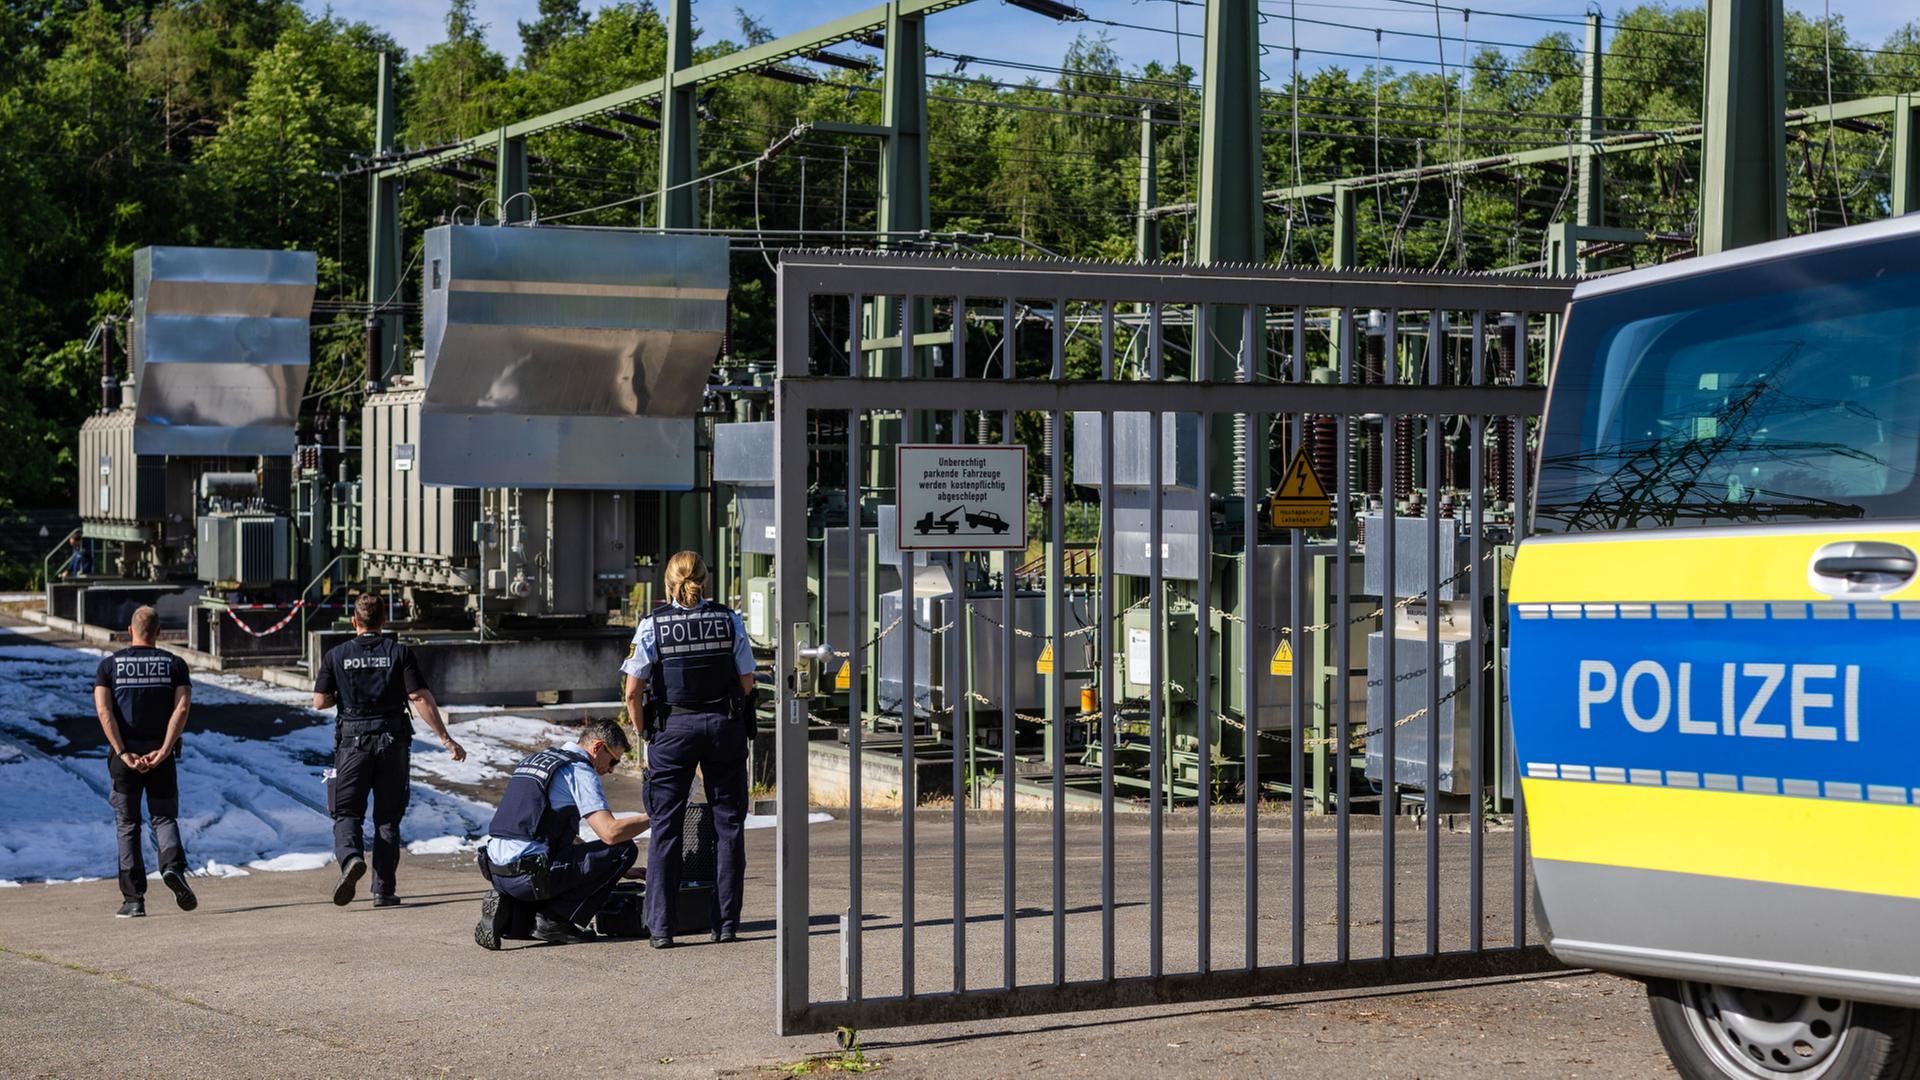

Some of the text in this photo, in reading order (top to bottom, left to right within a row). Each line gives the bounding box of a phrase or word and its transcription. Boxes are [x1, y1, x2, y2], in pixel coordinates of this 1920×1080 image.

[938, 457, 987, 468] Unberechtigt
[923, 469, 1001, 480] parkende Fahrzeuge
[919, 480, 1006, 491] werden kostenpflichtig
[937, 491, 988, 502] abgeschleppt
[659, 620, 731, 644] POLIZEI
[343, 656, 391, 670] POLIZEI
[116, 662, 171, 677] POLIZEI
[1578, 659, 1861, 742] POLIZEI
